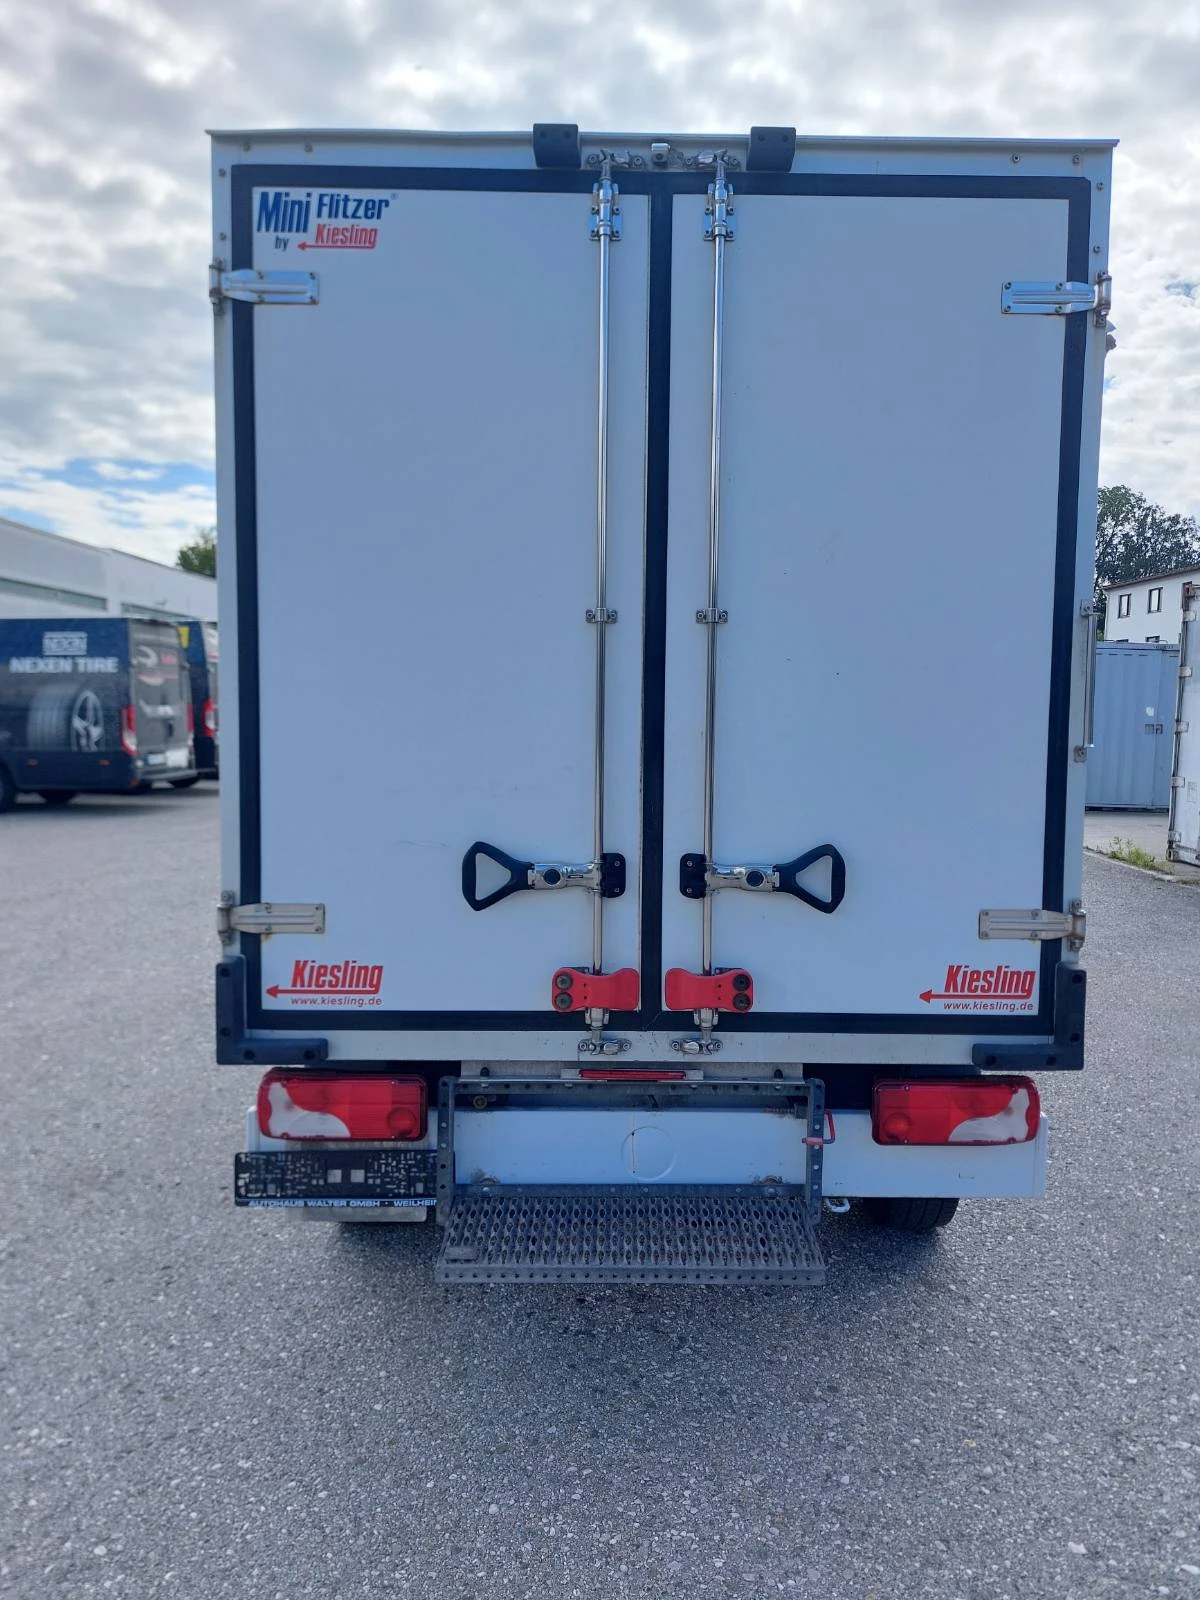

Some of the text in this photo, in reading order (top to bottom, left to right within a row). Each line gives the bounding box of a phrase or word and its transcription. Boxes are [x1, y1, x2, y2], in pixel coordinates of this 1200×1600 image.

[257, 191, 390, 233] Mini Flitzer
[274, 223, 378, 252] by Kiesling
[9, 656, 119, 674] NEXEN TIRE
[291, 960, 384, 995] Kiesling
[944, 964, 1036, 1000] Kiesling
[291, 996, 383, 1008] www.kiesling.de
[943, 1001, 1034, 1013] www.kiesling.de
[248, 1199, 305, 1208] AUTOHAUS
[307, 1199, 348, 1208] WALTER
